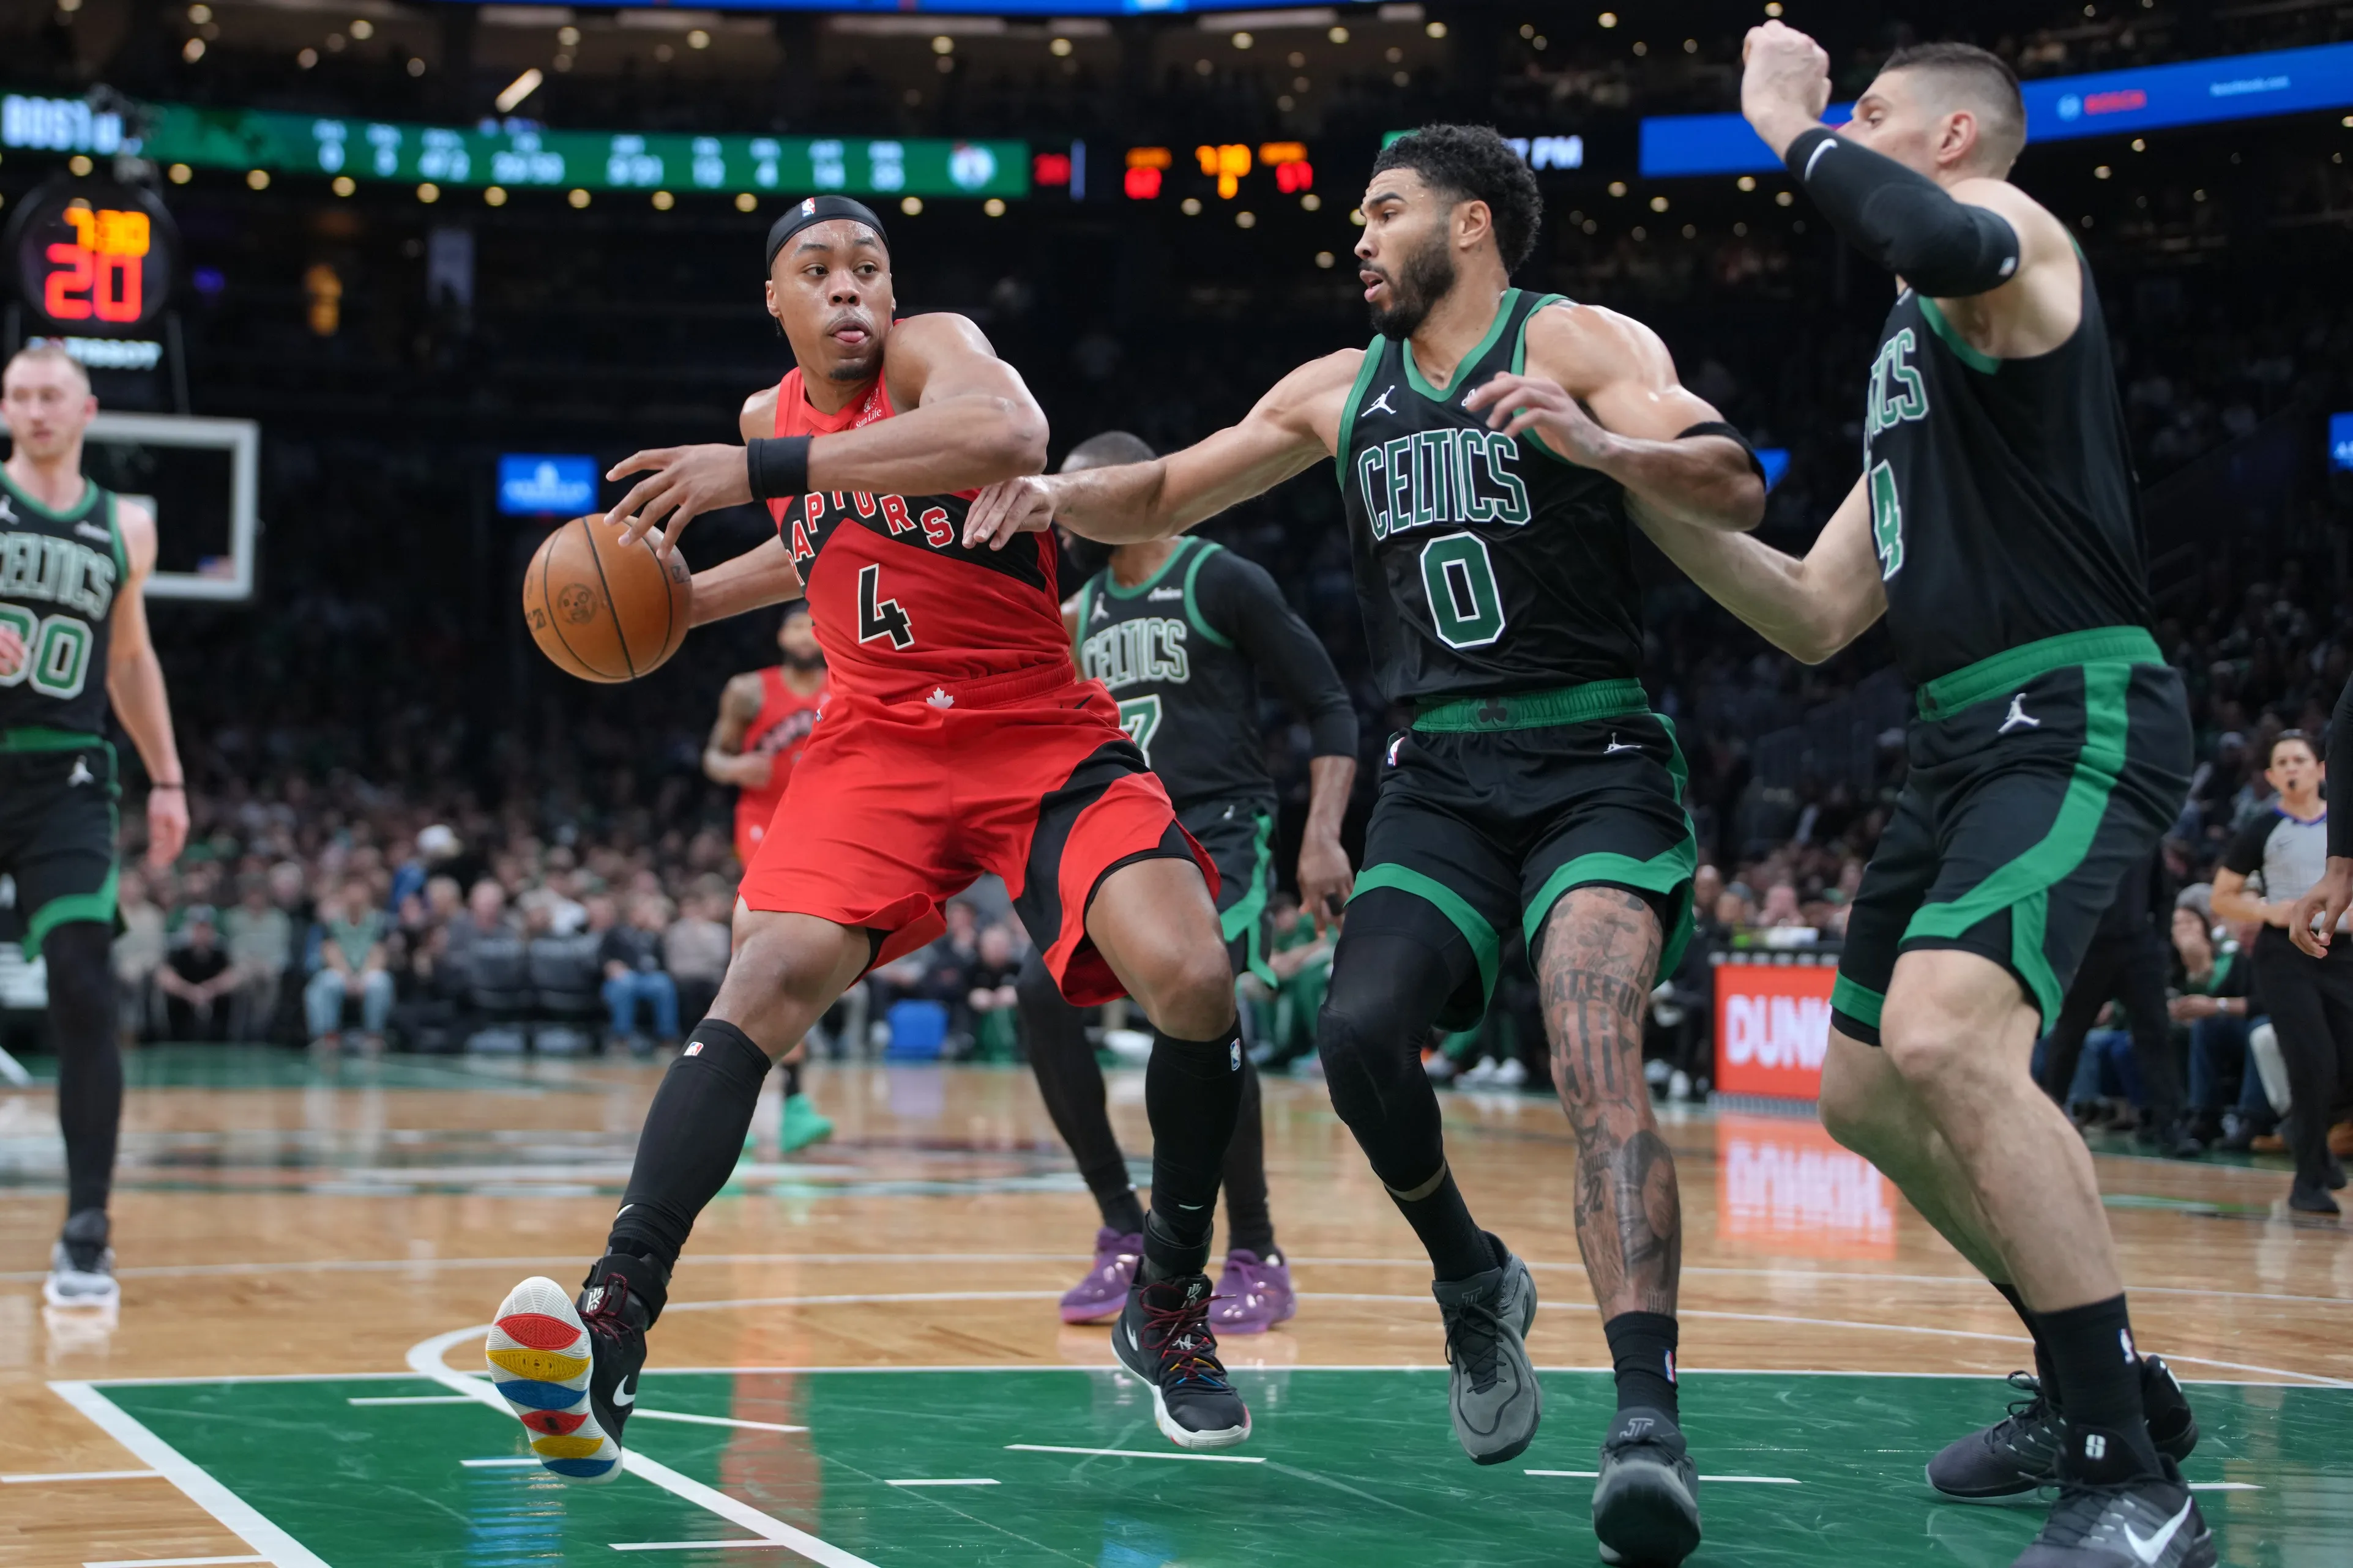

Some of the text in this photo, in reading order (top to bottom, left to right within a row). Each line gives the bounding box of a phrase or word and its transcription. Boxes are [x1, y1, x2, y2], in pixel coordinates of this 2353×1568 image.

[1531, 135, 1584, 171] PM
[45, 243, 143, 323] 20
[856, 407, 882, 429] Sun Life
[1358, 428, 1531, 541] CELTICS
[858, 562, 915, 650] 4
[1420, 532, 1505, 649] 0
[1081, 617, 1191, 692] CELTICS
